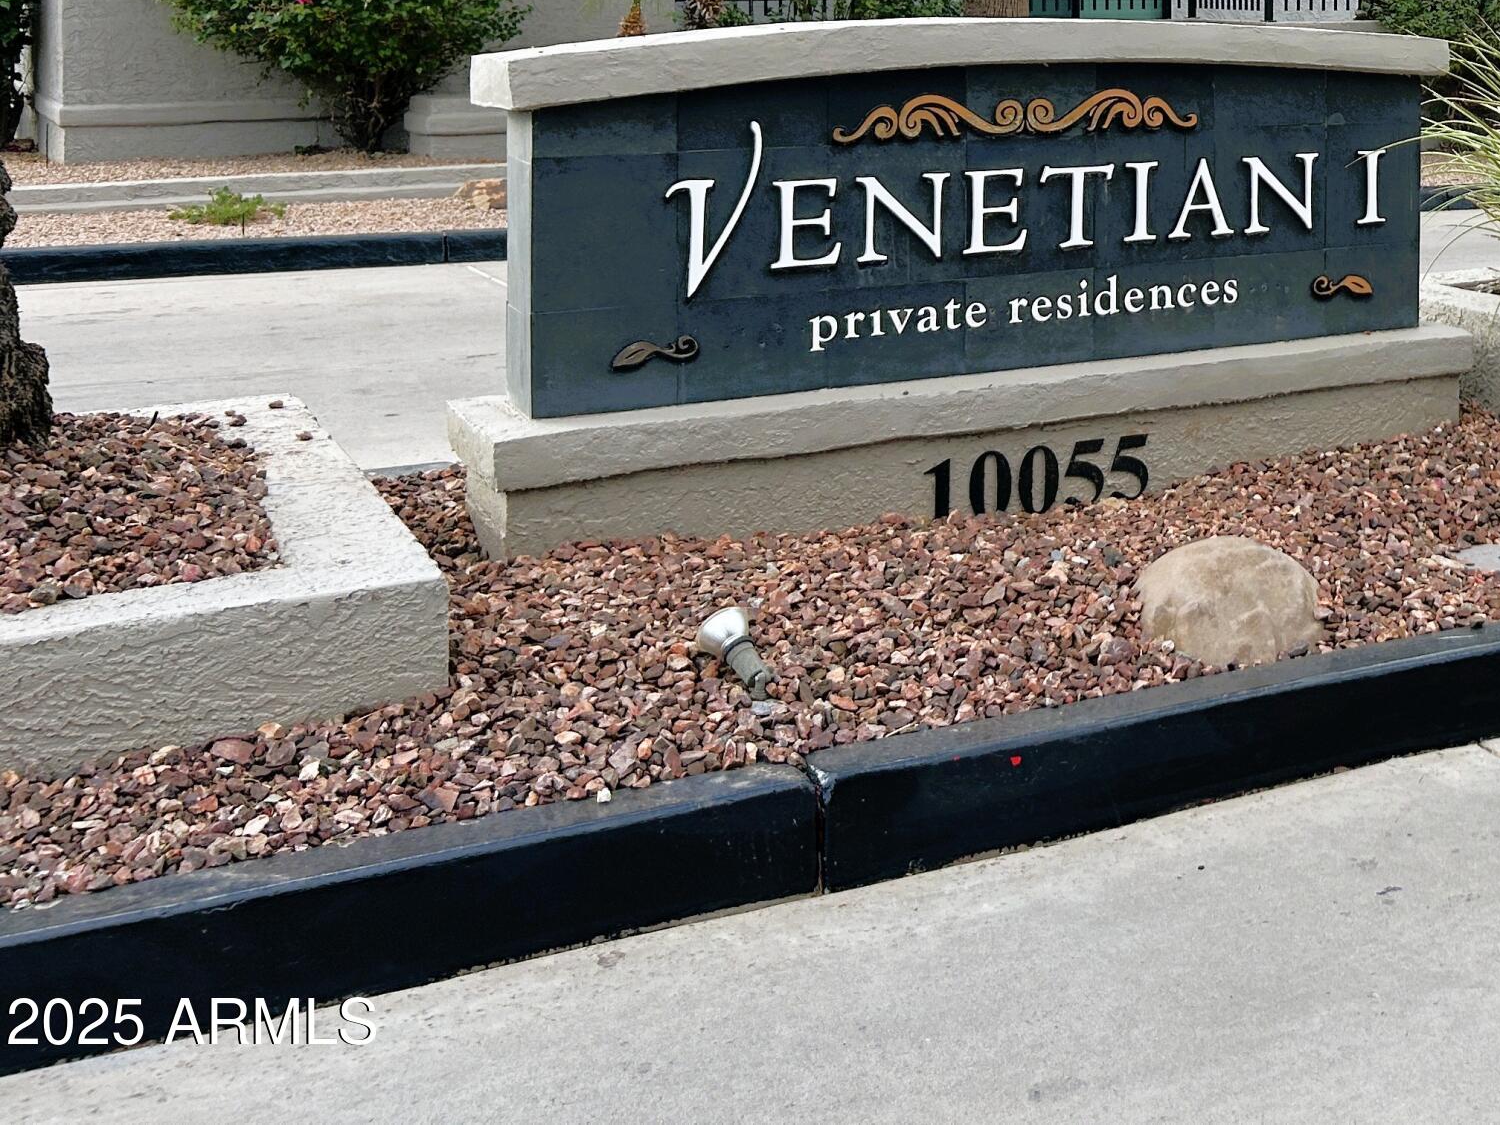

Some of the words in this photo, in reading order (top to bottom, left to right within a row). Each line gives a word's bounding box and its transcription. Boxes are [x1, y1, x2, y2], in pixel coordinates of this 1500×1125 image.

[664, 120, 1320, 299] VENETIAN
[1355, 148, 1387, 226] I
[808, 297, 988, 353] private
[1008, 274, 1239, 325] residences
[923, 433, 1149, 520] 10055
